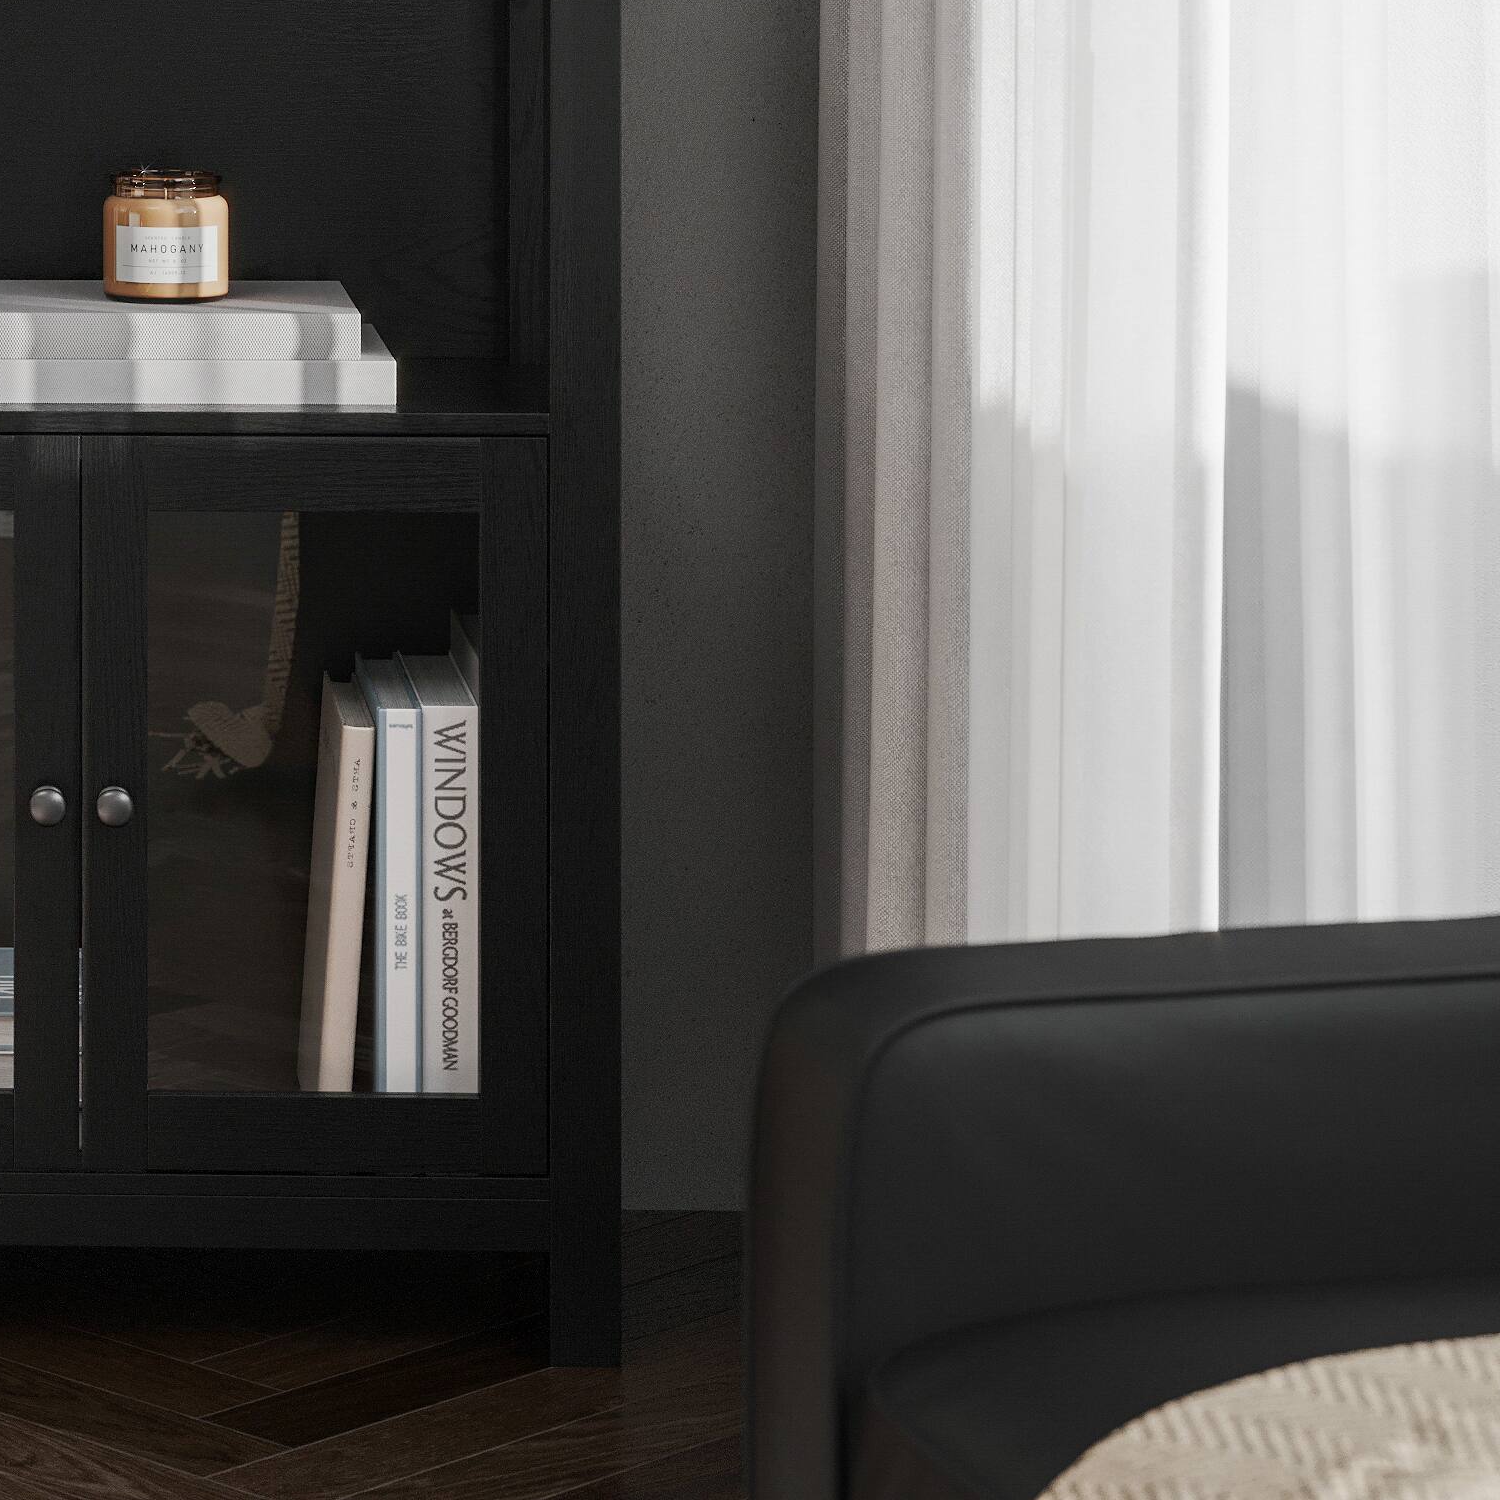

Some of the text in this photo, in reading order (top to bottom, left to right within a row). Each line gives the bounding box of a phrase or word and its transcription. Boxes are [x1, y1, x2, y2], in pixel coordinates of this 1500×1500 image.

[130, 243, 204, 254] MAHOGANY
[394, 893, 408, 971] THE BIKE BOOK
[433, 719, 468, 1071] WINDOWS at BERGDORF GOODMAN
